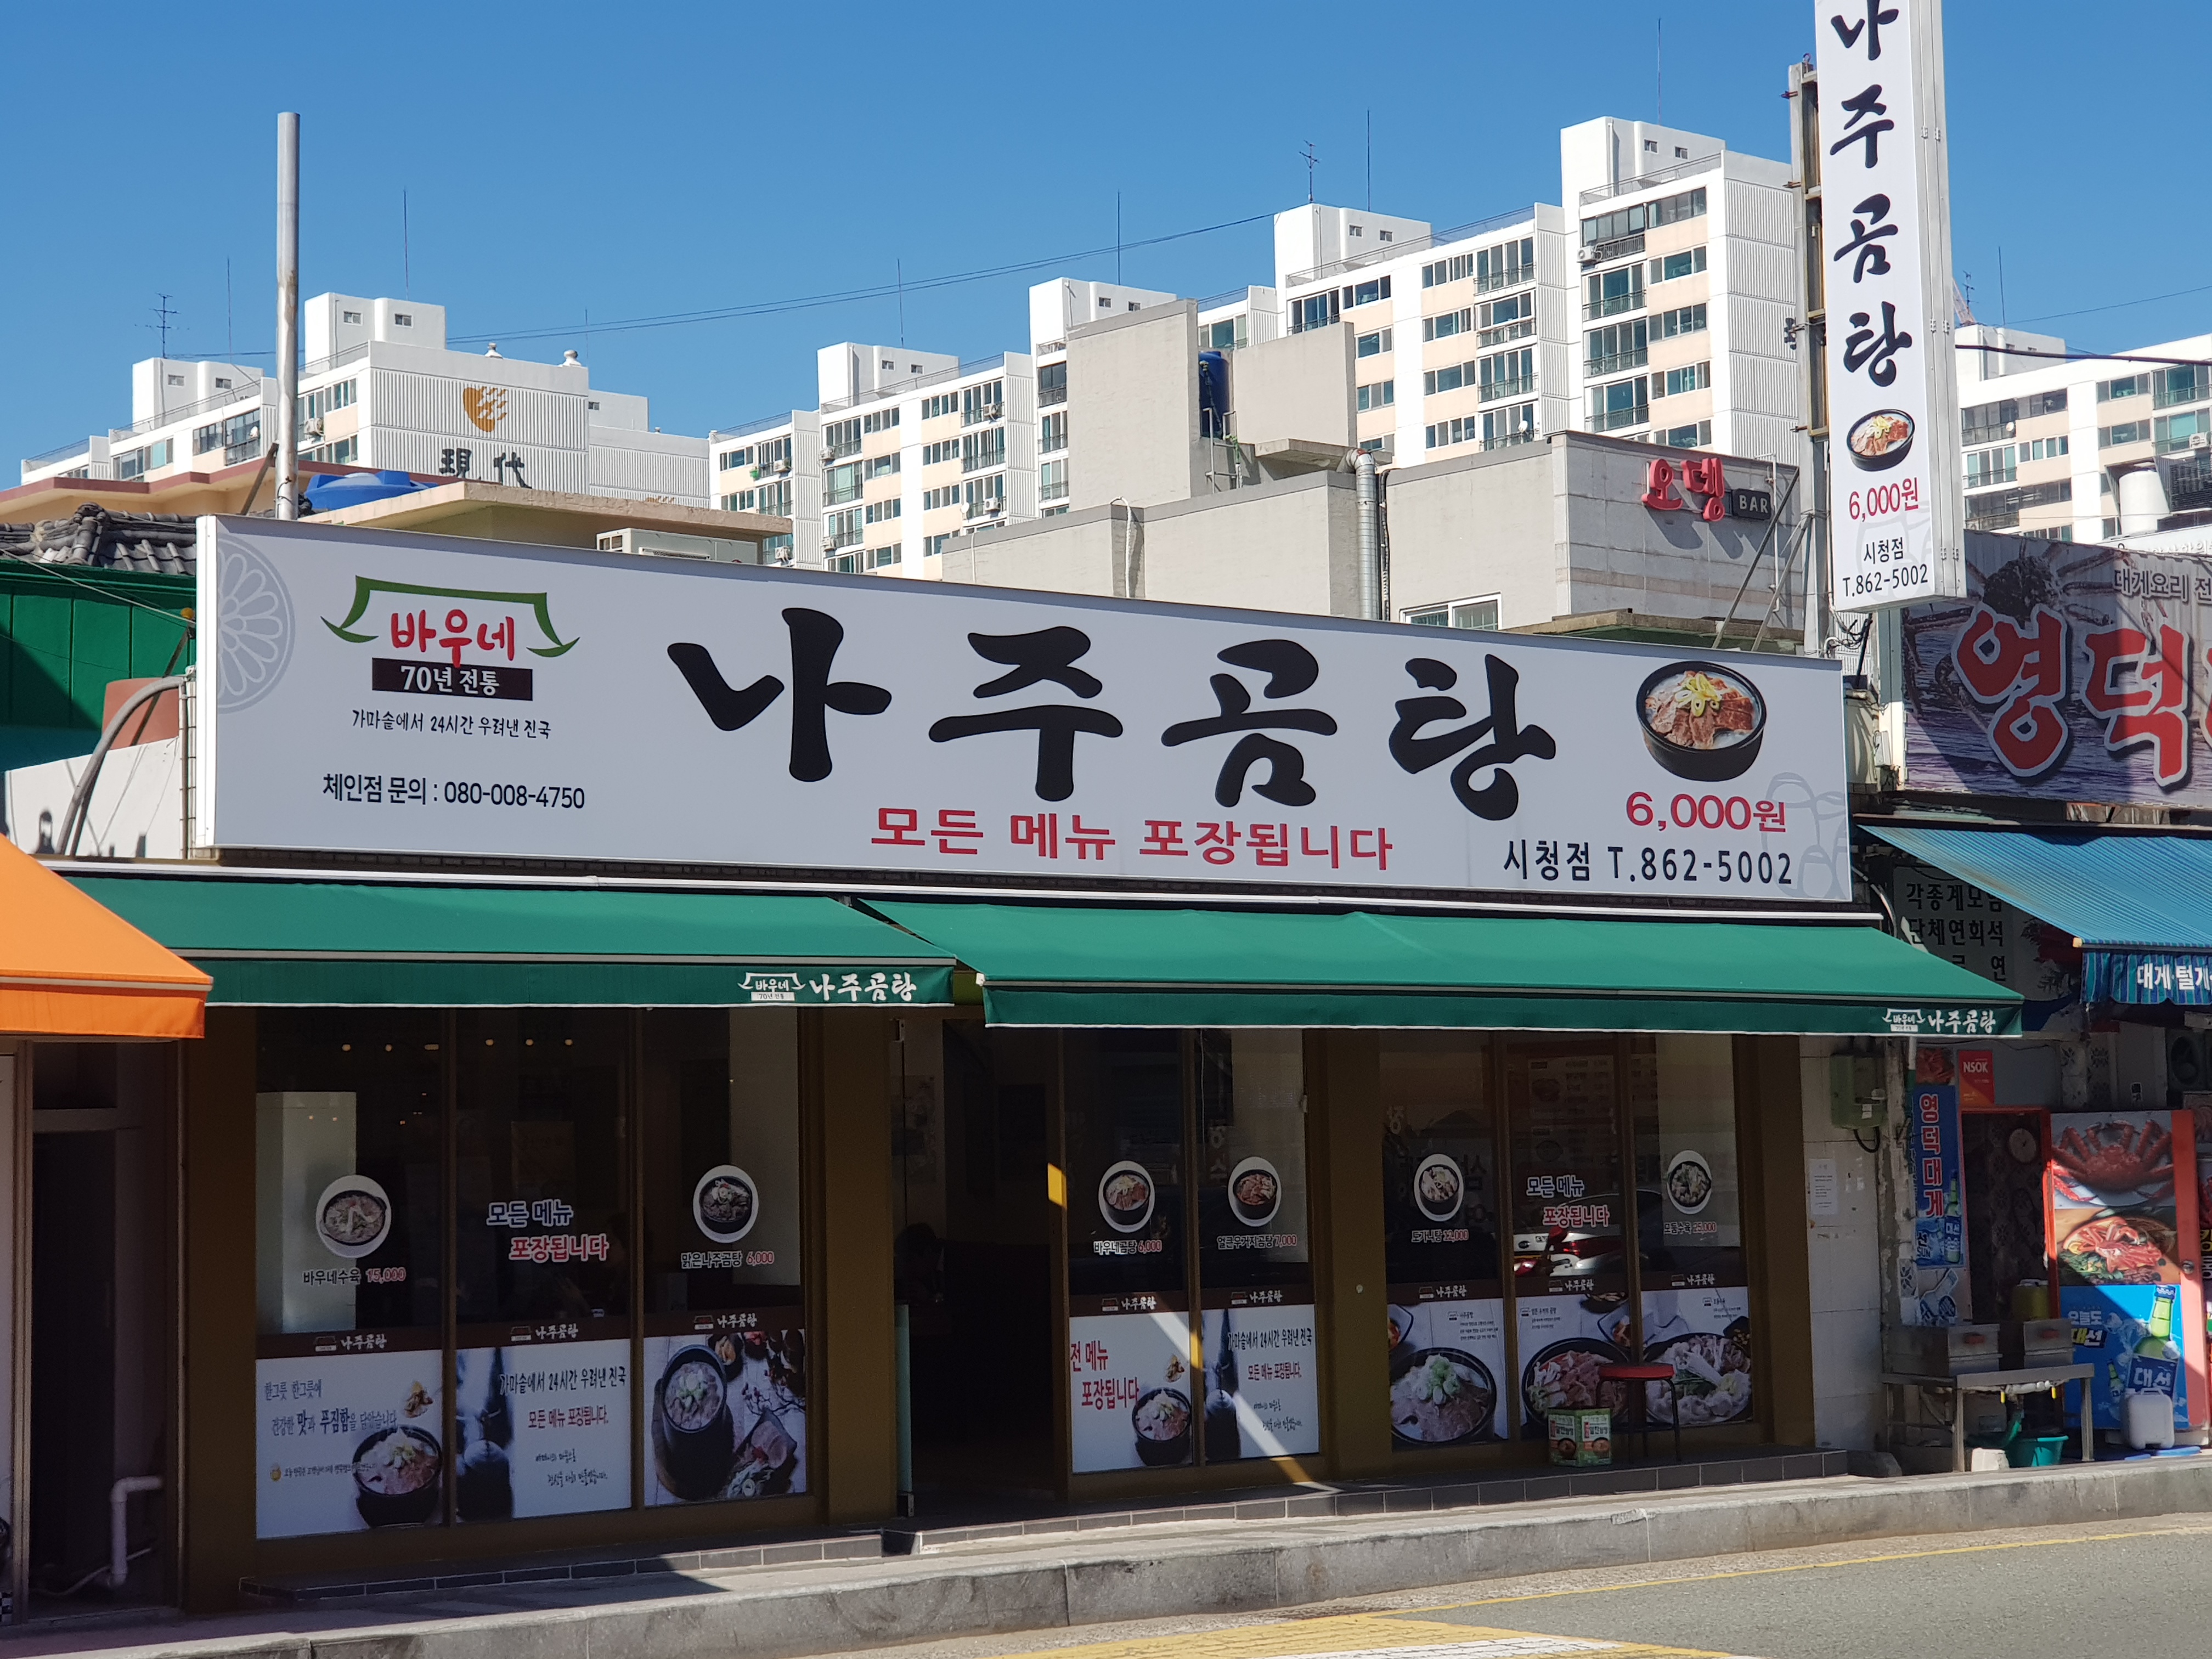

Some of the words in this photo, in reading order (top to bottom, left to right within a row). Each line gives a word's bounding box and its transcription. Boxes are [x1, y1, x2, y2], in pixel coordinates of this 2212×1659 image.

[1830, 0, 1913, 387] 나주곰탕
[439, 448, 532, 489] 現代
[1641, 458, 1725, 521] 오뎅
[1849, 477, 1919, 523] 6,000원
[1739, 495, 1769, 514] BAR
[1864, 537, 1904, 565] 시청점
[1843, 563, 1928, 598] T.862-5002
[2114, 567, 2188, 602] 대게요리
[390, 608, 515, 668] 바우네
[400, 665, 453, 694] 70년
[459, 669, 500, 697] 전통
[1952, 605, 2212, 788] 영덕
[352, 709, 424, 733] 가마솥에서
[430, 714, 475, 737] 24시간
[478, 716, 520, 739] 우려낸
[524, 719, 552, 740] 진국
[667, 607, 1556, 821] 나주곰탕
[323, 772, 383, 804] 체인점
[387, 777, 427, 806] 문의
[443, 781, 585, 810] 080-008-4750
[1626, 791, 1786, 833] 6,000원
[871, 808, 984, 856] 모든
[1010, 812, 1116, 860] 메뉴
[1139, 819, 1393, 871] 포장됩니다
[1503, 839, 1590, 882] 시청점
[1607, 846, 1792, 885] T.862-5002
[1908, 918, 2004, 947] 단체연회석
[755, 979, 789, 992] 바우네
[809, 972, 917, 1002] 나주곰탕
[1927, 1009, 1996, 1035] 나주곰탕
[1963, 1061, 1988, 1073] NSOK
[1526, 1175, 1555, 1198] 모든
[1556, 1174, 1585, 1198] 메뉴
[486, 1200, 529, 1228] 모든
[532, 1198, 573, 1227] 메뉴
[1542, 1204, 1610, 1228] 포장됩니다
[508, 1233, 610, 1264] 포장됩니다
[1093, 1240, 1138, 1256] 바우네곰탕
[1137, 1239, 1163, 1255] 6,000
[1216, 1234, 1274, 1250] 얼큰우거지곰탕
[1274, 1234, 1298, 1248] 7,000
[1411, 1229, 1443, 1243] 도가니탕
[746, 1250, 775, 1266] 6,000
[302, 1268, 362, 1285] 바우네수육
[365, 1267, 407, 1284] 15,000
[1121, 1296, 1158, 1311] 나주곰탕
[1249, 1289, 1283, 1304] 나주곰탕
[535, 1323, 579, 1340] 나주곰탕
[716, 1313, 758, 1329] 나주곰탕
[340, 1334, 387, 1351] 나주곰탕
[1227, 1330, 1258, 1352] 가마솥에서
[1260, 1329, 1280, 1348] 24시간
[1281, 1328, 1299, 1347] 우려낸
[1301, 1327, 1312, 1346] 진국
[1070, 1342, 1081, 1372] 전
[1085, 1340, 1109, 1371] 메뉴
[500, 1371, 545, 1396] 가마솥에서
[549, 1369, 577, 1392] 24시간
[580, 1367, 606, 1389] 우려낸
[609, 1365, 627, 1386] 진국
[1248, 1364, 1260, 1381] 모든
[1261, 1363, 1273, 1380] 메뉴
[1081, 1377, 1139, 1410] 포장됩니다
[297, 1409, 316, 1436] 맛과
[320, 1407, 357, 1435] 푸짐함을
[528, 1409, 546, 1429] 모든
[549, 1408, 566, 1428] 메뉴
